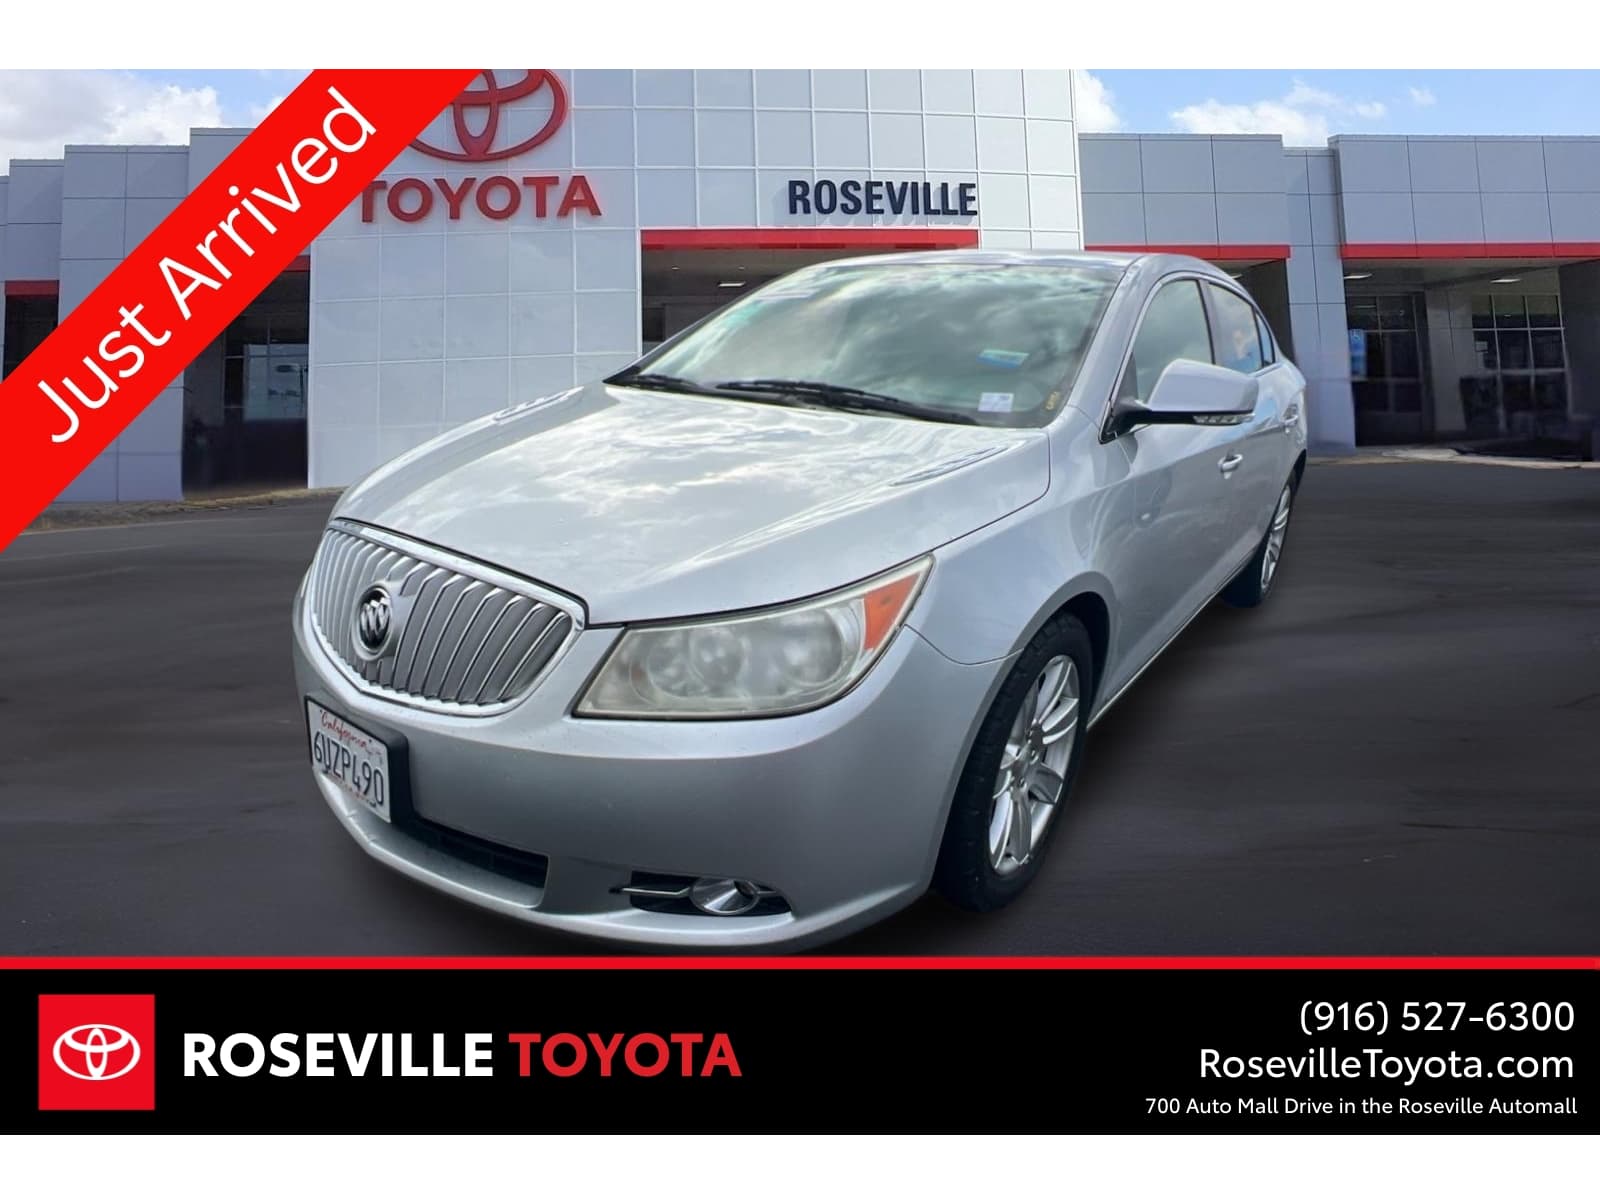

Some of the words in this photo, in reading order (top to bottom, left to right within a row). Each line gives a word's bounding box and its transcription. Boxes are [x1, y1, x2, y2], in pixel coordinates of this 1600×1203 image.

[361, 175, 602, 223] TOYOTA
[788, 179, 978, 216] ROSEVILLE
[313, 731, 385, 806] 6UZP490
